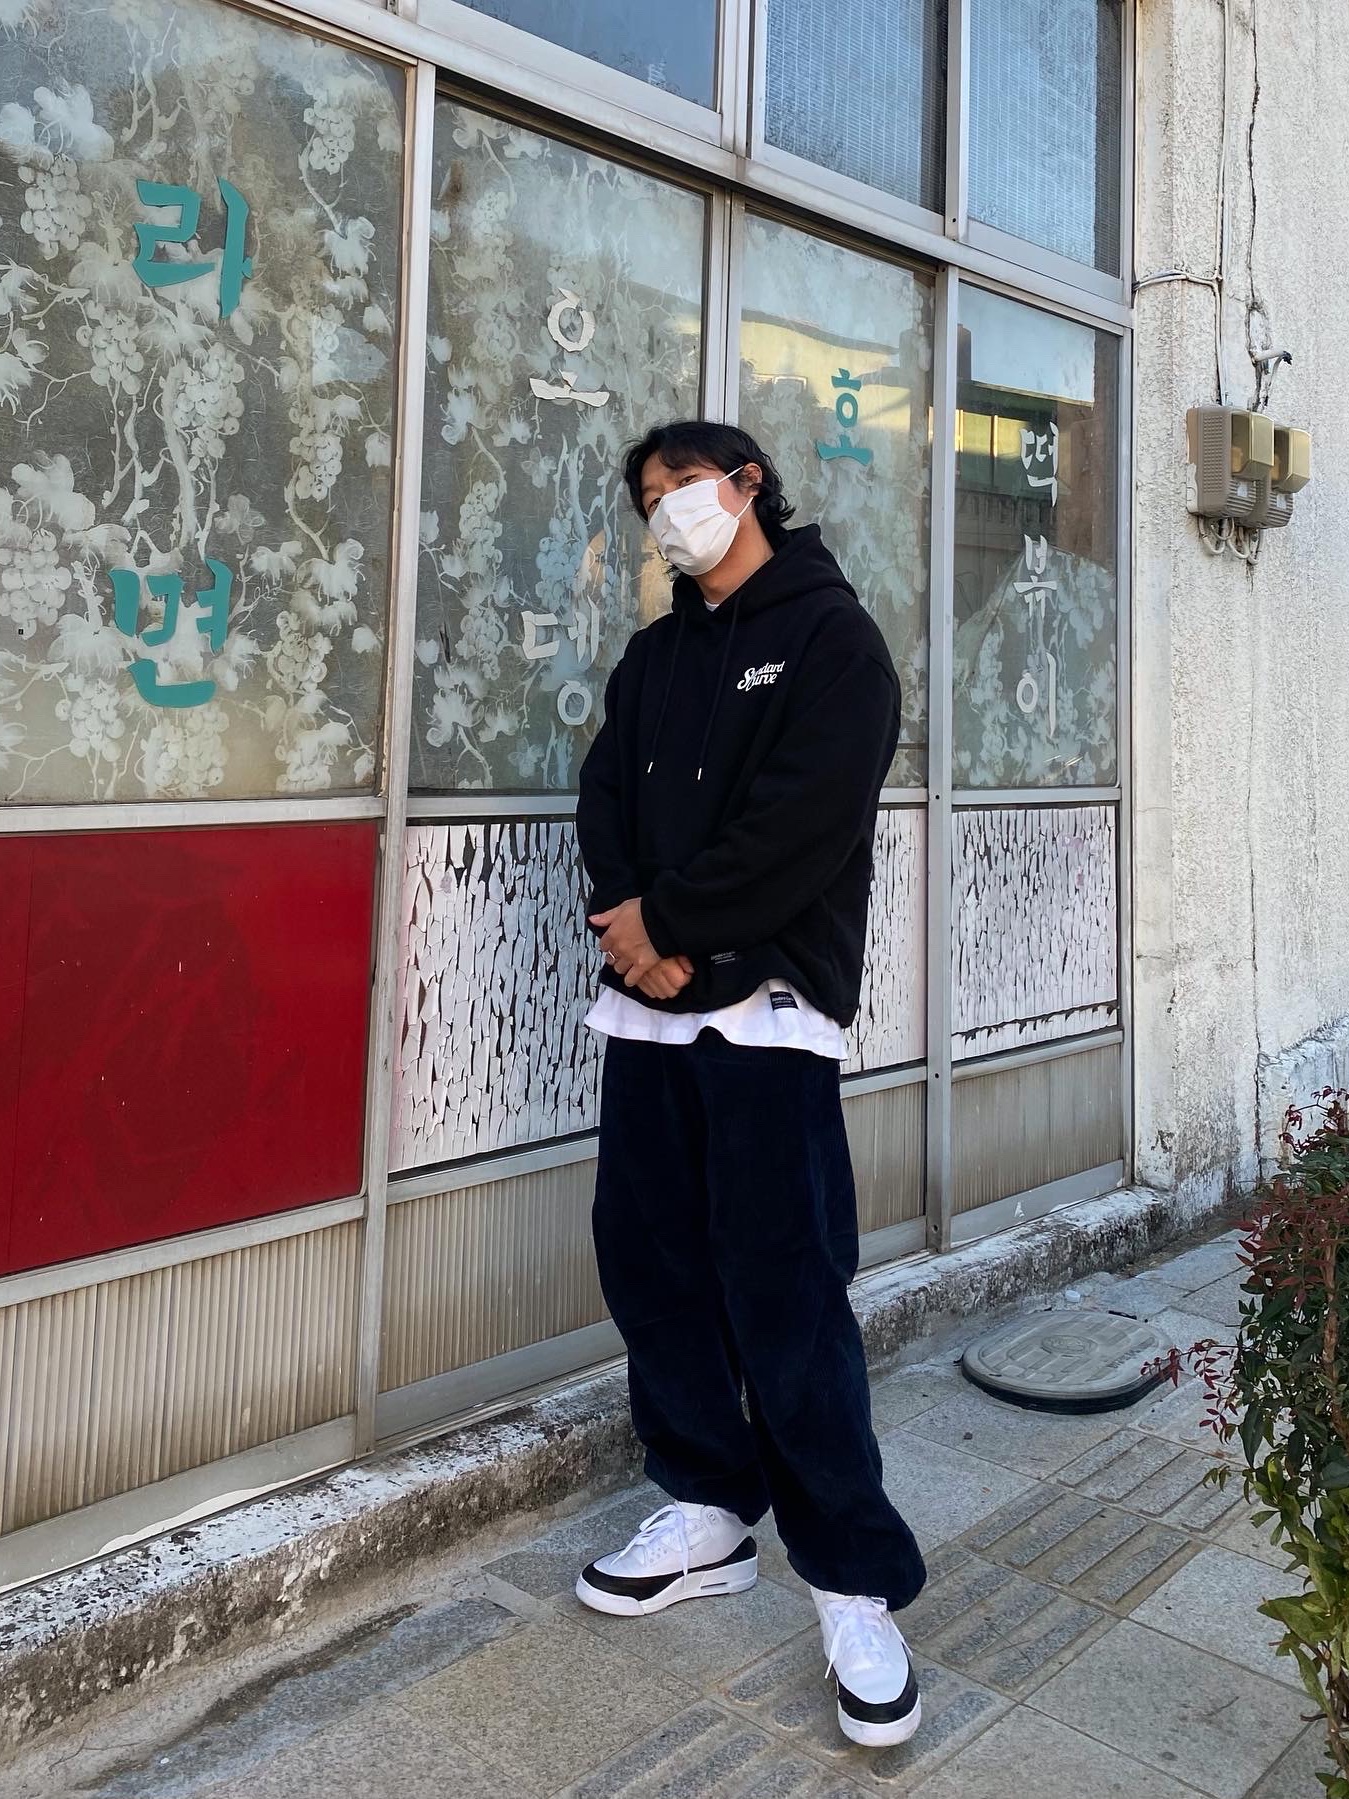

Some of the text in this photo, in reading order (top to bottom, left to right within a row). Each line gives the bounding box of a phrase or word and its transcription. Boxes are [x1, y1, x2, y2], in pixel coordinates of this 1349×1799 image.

[108, 176, 253, 708] 라면
[520, 287, 610, 727] 오뎅
[1013, 421, 1060, 738] 떡볶이
